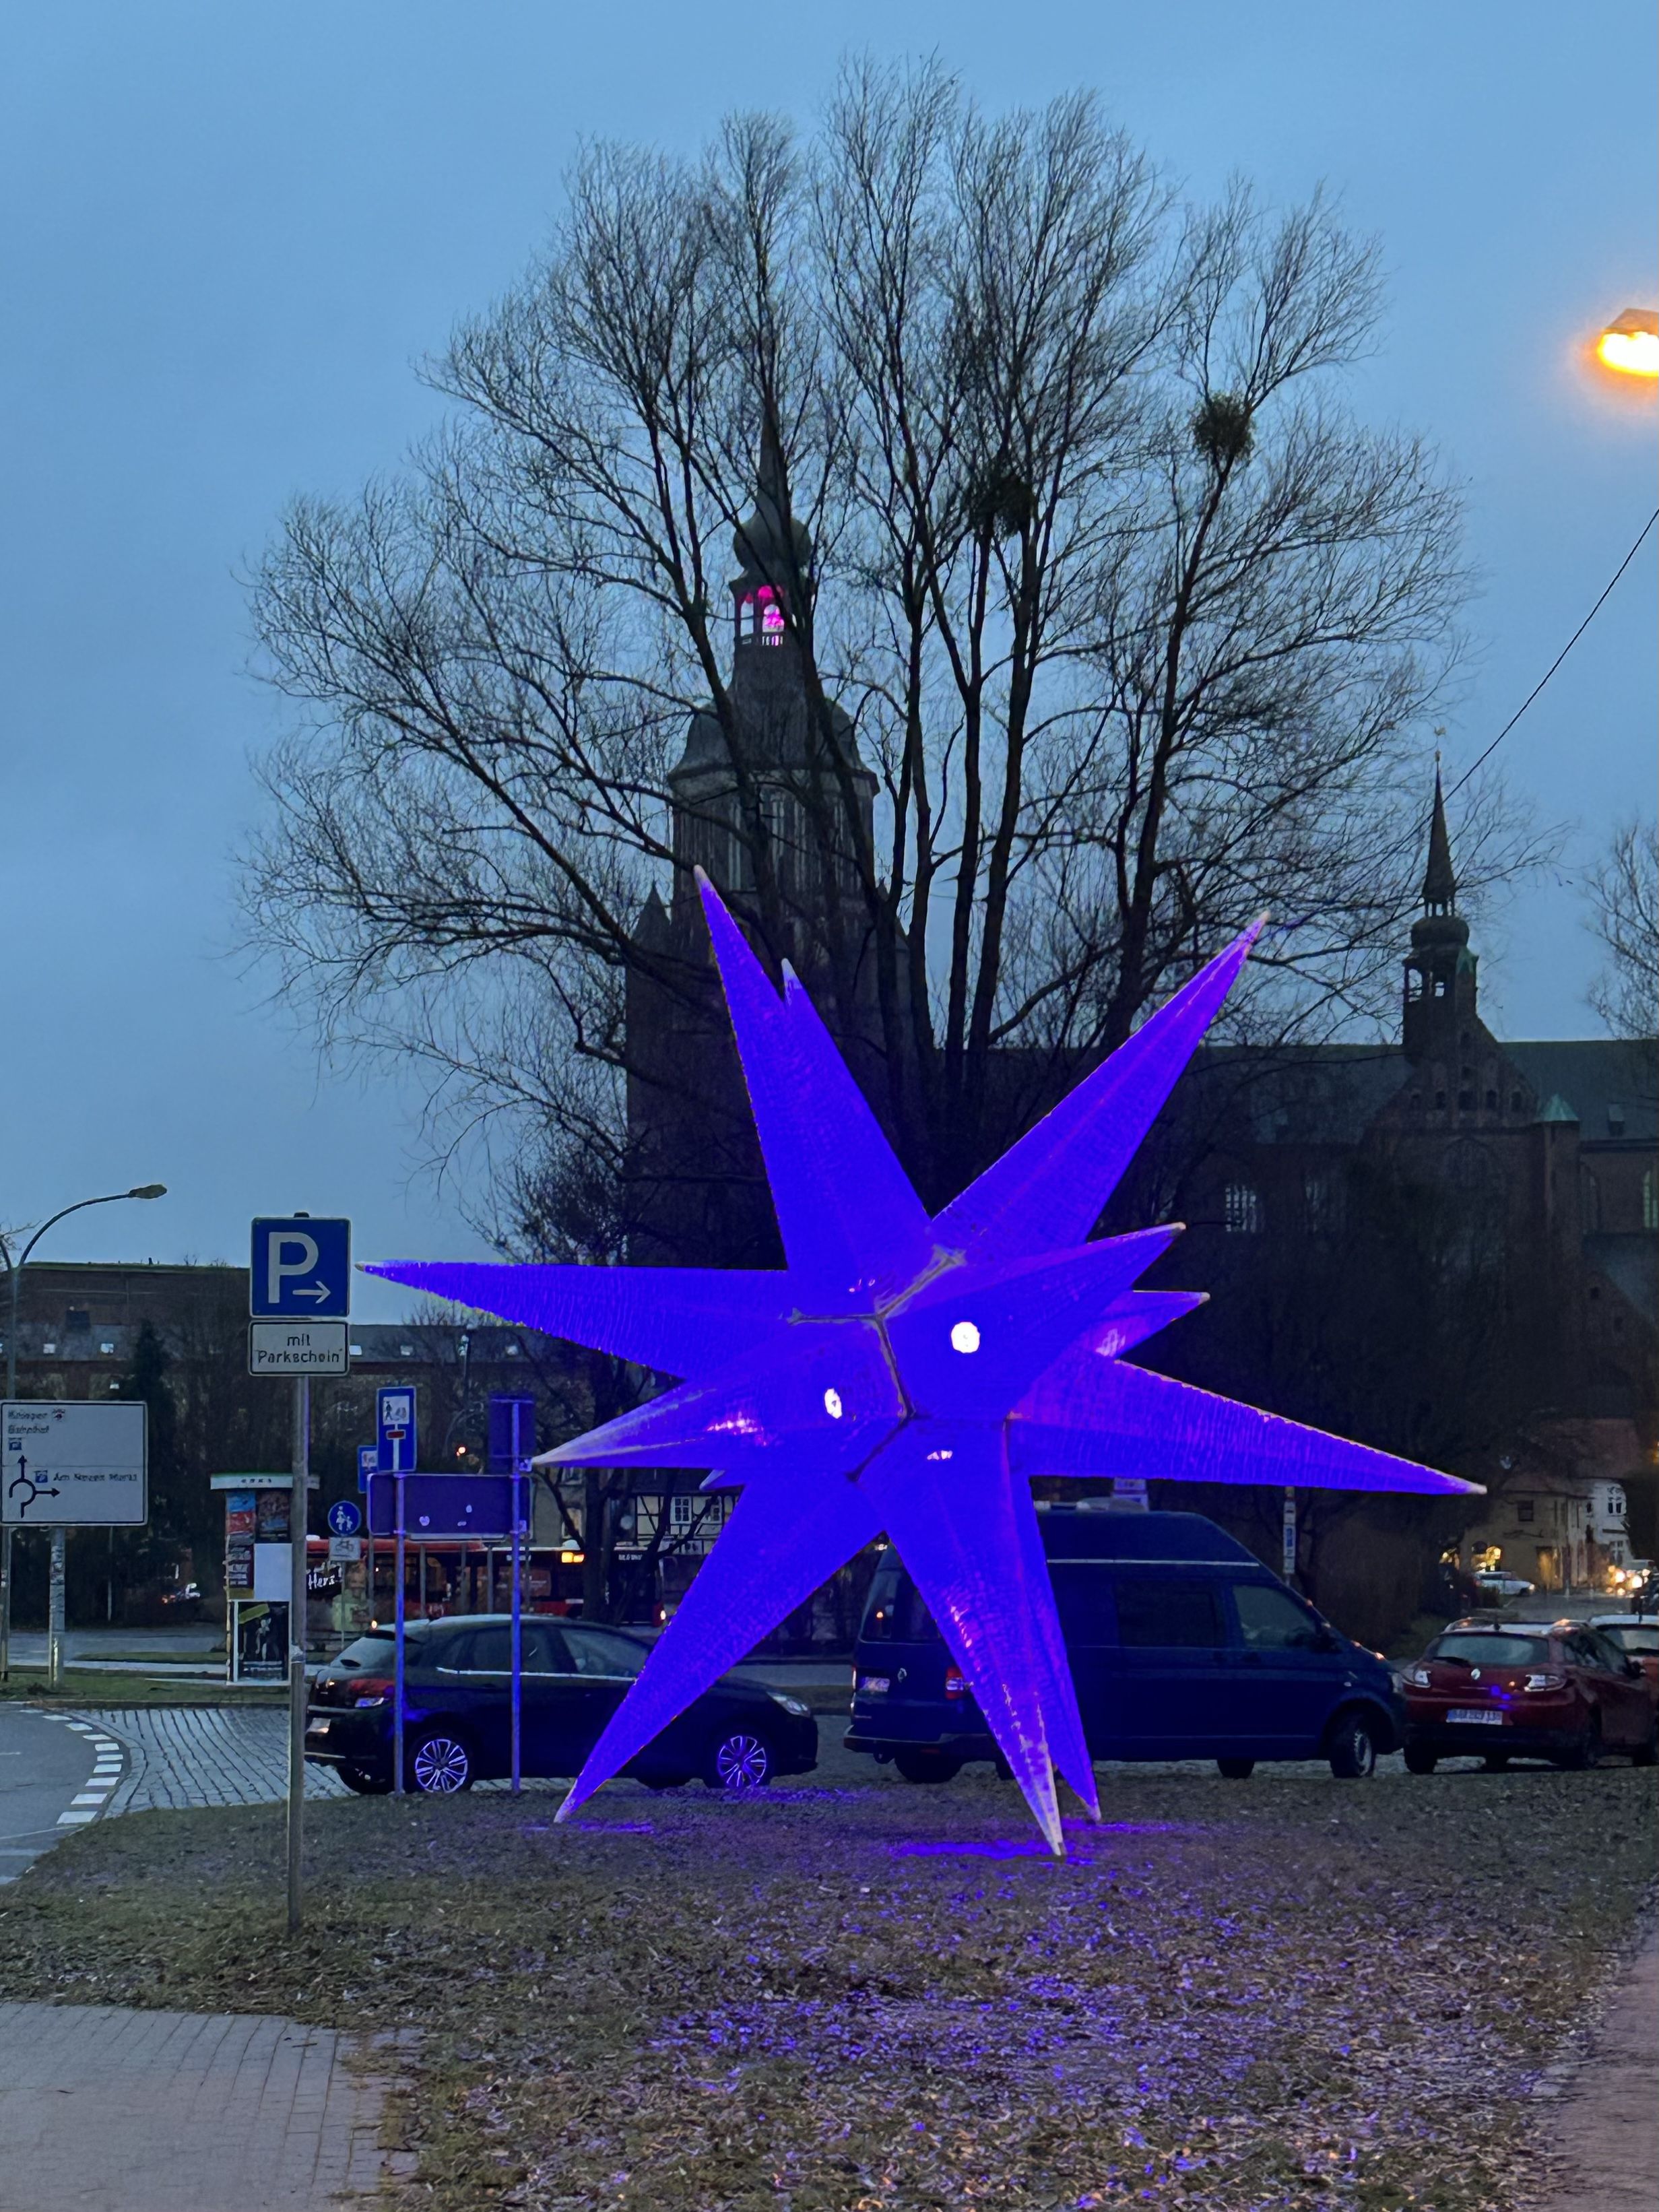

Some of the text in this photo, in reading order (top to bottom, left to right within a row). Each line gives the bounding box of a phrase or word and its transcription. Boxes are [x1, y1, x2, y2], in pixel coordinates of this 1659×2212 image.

[268, 1232, 319, 1303] P
[287, 1333, 310, 1346] mit
[257, 1350, 341, 1363] Parkschein
